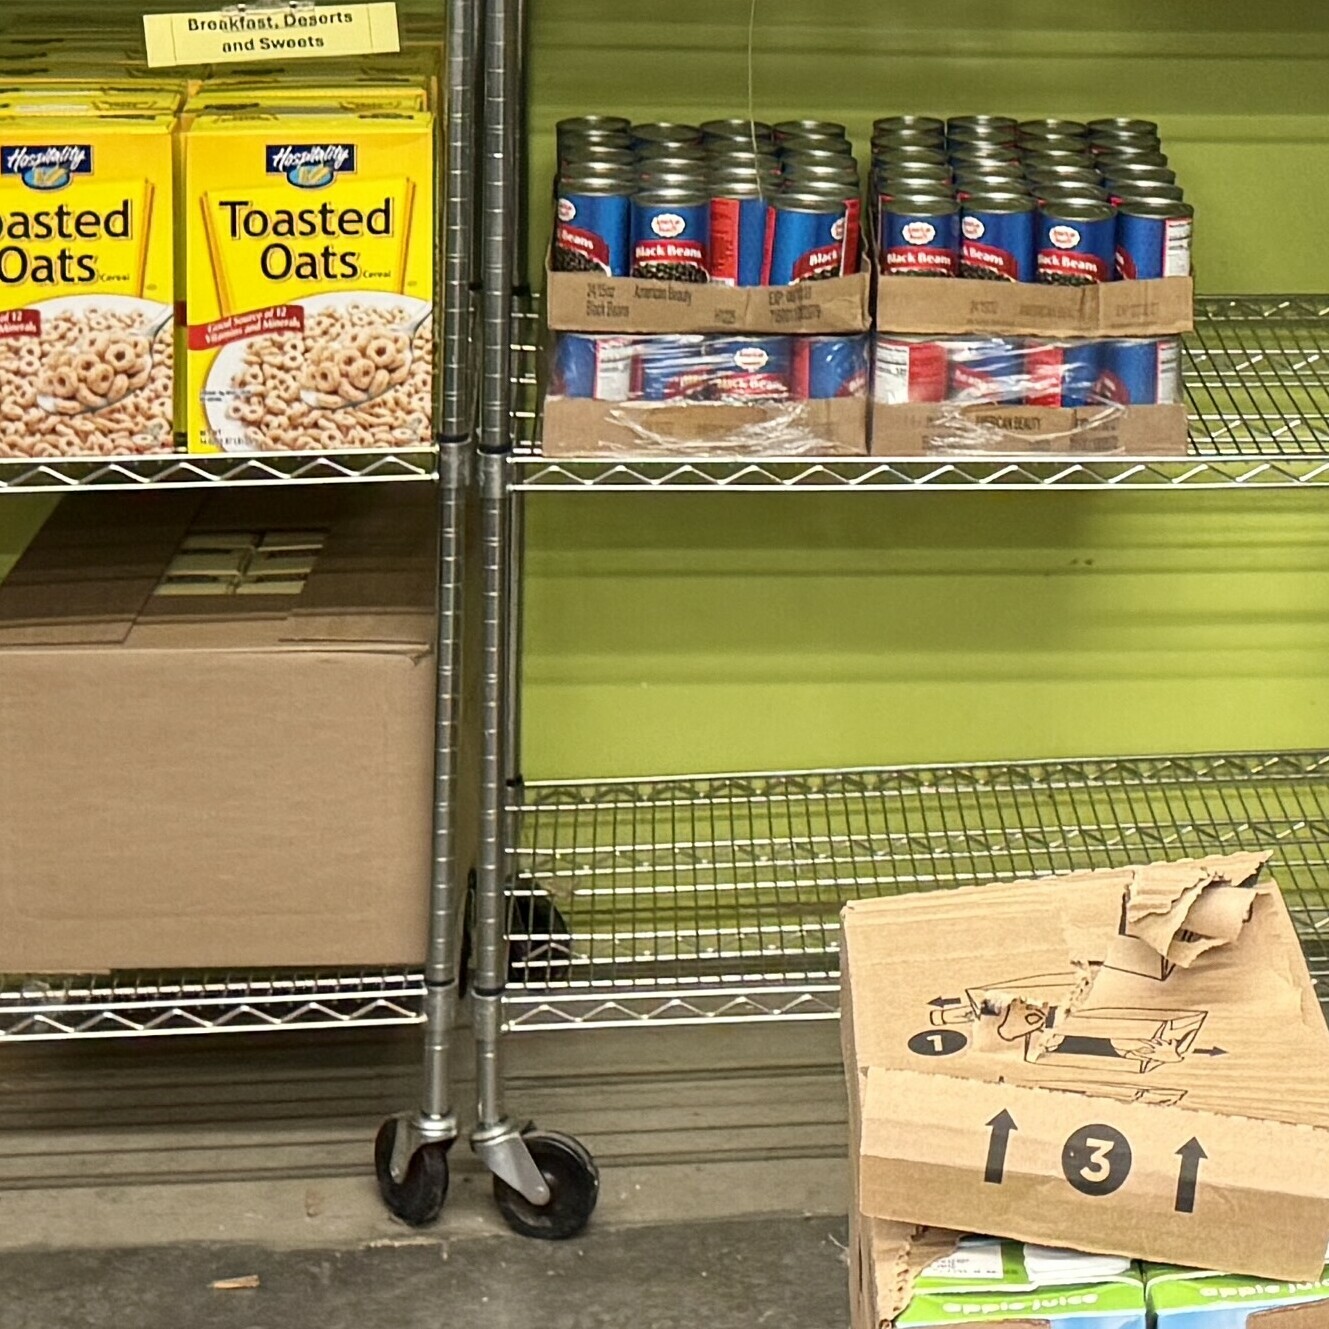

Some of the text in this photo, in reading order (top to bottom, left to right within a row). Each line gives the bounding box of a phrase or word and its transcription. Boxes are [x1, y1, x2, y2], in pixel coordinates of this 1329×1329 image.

[187, 9, 354, 33] Breakfast, Deserts
[222, 35, 325, 54] and Sweets
[6, 145, 87, 174] Hospitality
[272, 144, 350, 174] Hospitality
[218, 198, 392, 239] Toasted
[260, 245, 359, 282] Oats
[635, 244, 702, 259] Black Beans
[886, 253, 951, 265] Black Beans
[969, 249, 1004, 266] Beans
[0, 245, 97, 283] Oats
[925, 1033, 951, 1053] 1
[1080, 1139, 1115, 1183] 3
[1200, 1282, 1281, 1300] apple
[941, 1292, 1099, 1316] apple juice
